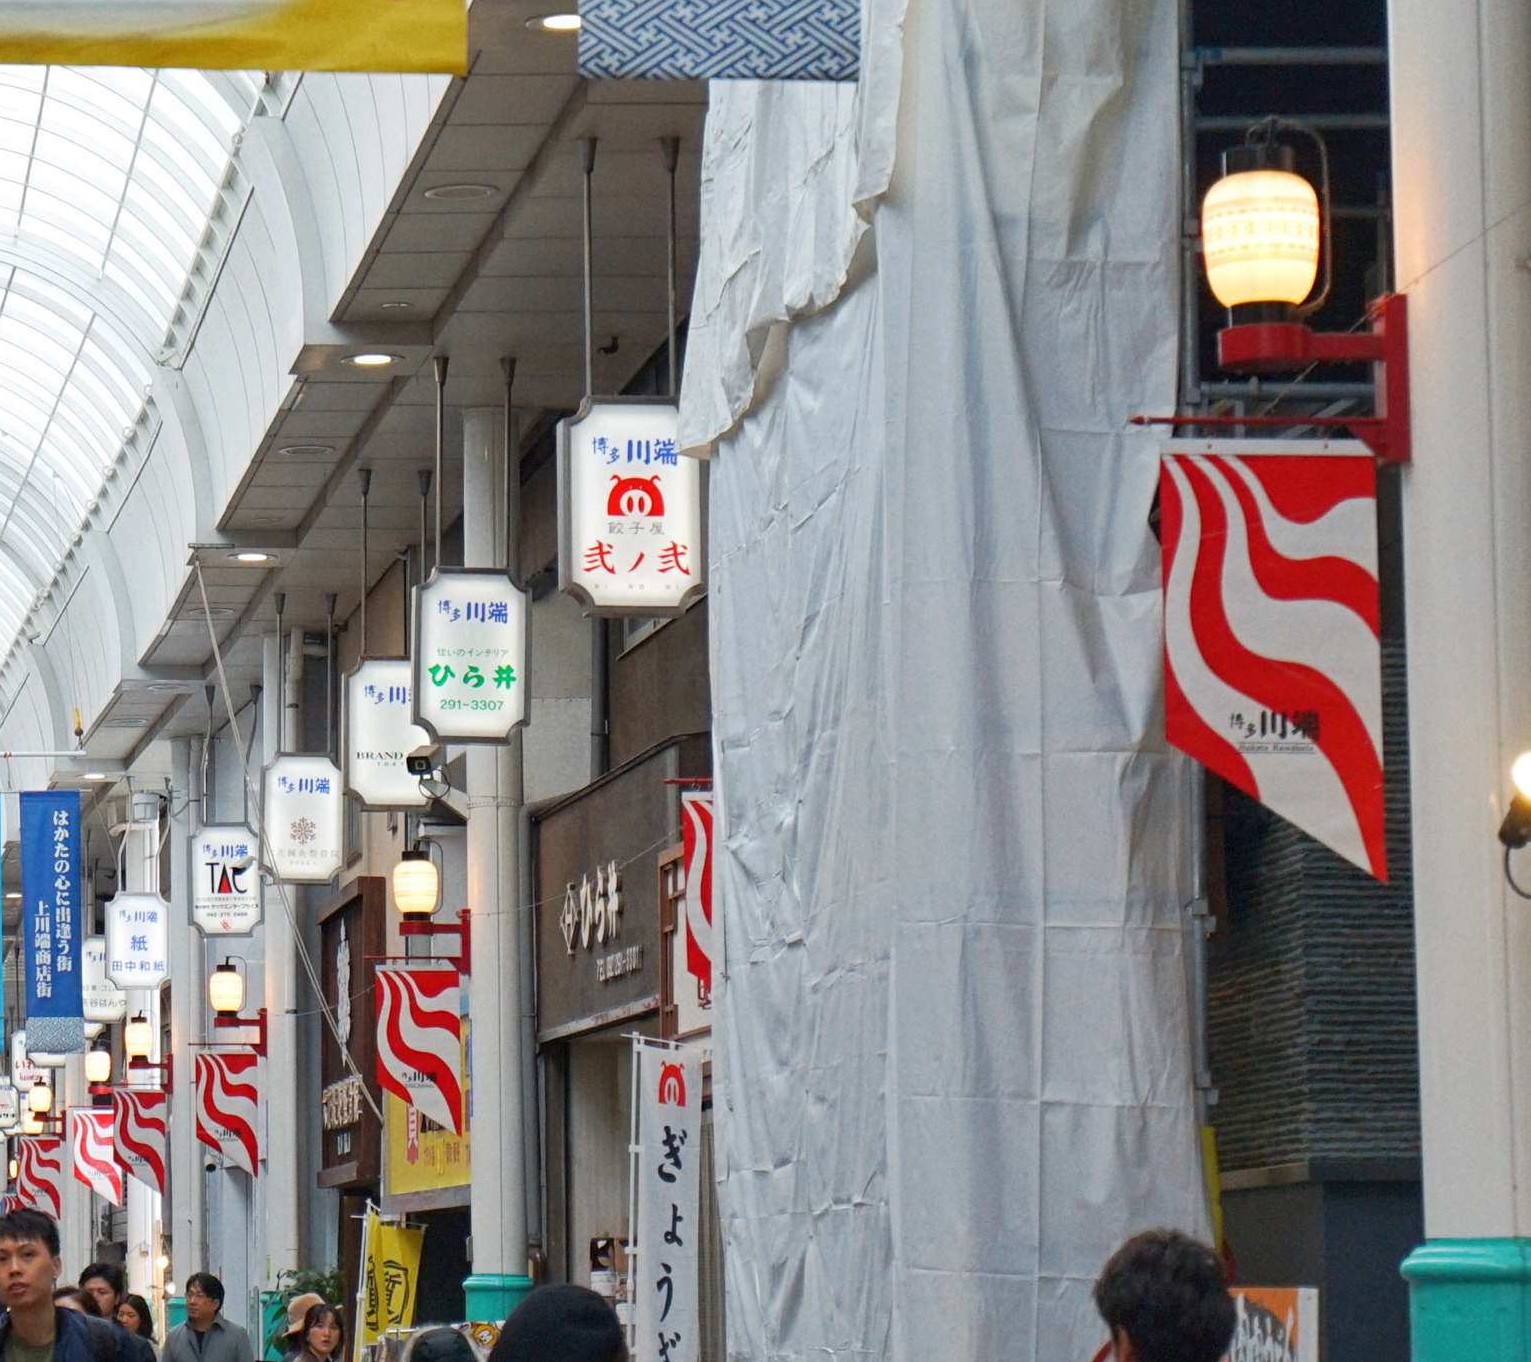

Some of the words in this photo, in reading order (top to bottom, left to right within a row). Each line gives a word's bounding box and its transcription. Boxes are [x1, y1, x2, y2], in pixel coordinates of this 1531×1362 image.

[591, 436, 678, 467] 博多川端
[607, 521, 666, 537] 餃子屋
[582, 540, 691, 577] 弐ノ弐
[437, 599, 509, 624] 博多川端
[427, 662, 517, 690] ひら井
[363, 685, 411, 705] 博多川
[439, 698, 505, 712] 291-3307
[356, 751, 404, 760] BRAND
[277, 776, 331, 795] 博多川端
[205, 862, 247, 894] TAC
[53, 810, 72, 972] はかたの心に出逢う街
[34, 900, 51, 999] 上川端商店街
[130, 936, 148, 952] 紙
[112, 960, 165, 973] 田中和紙
